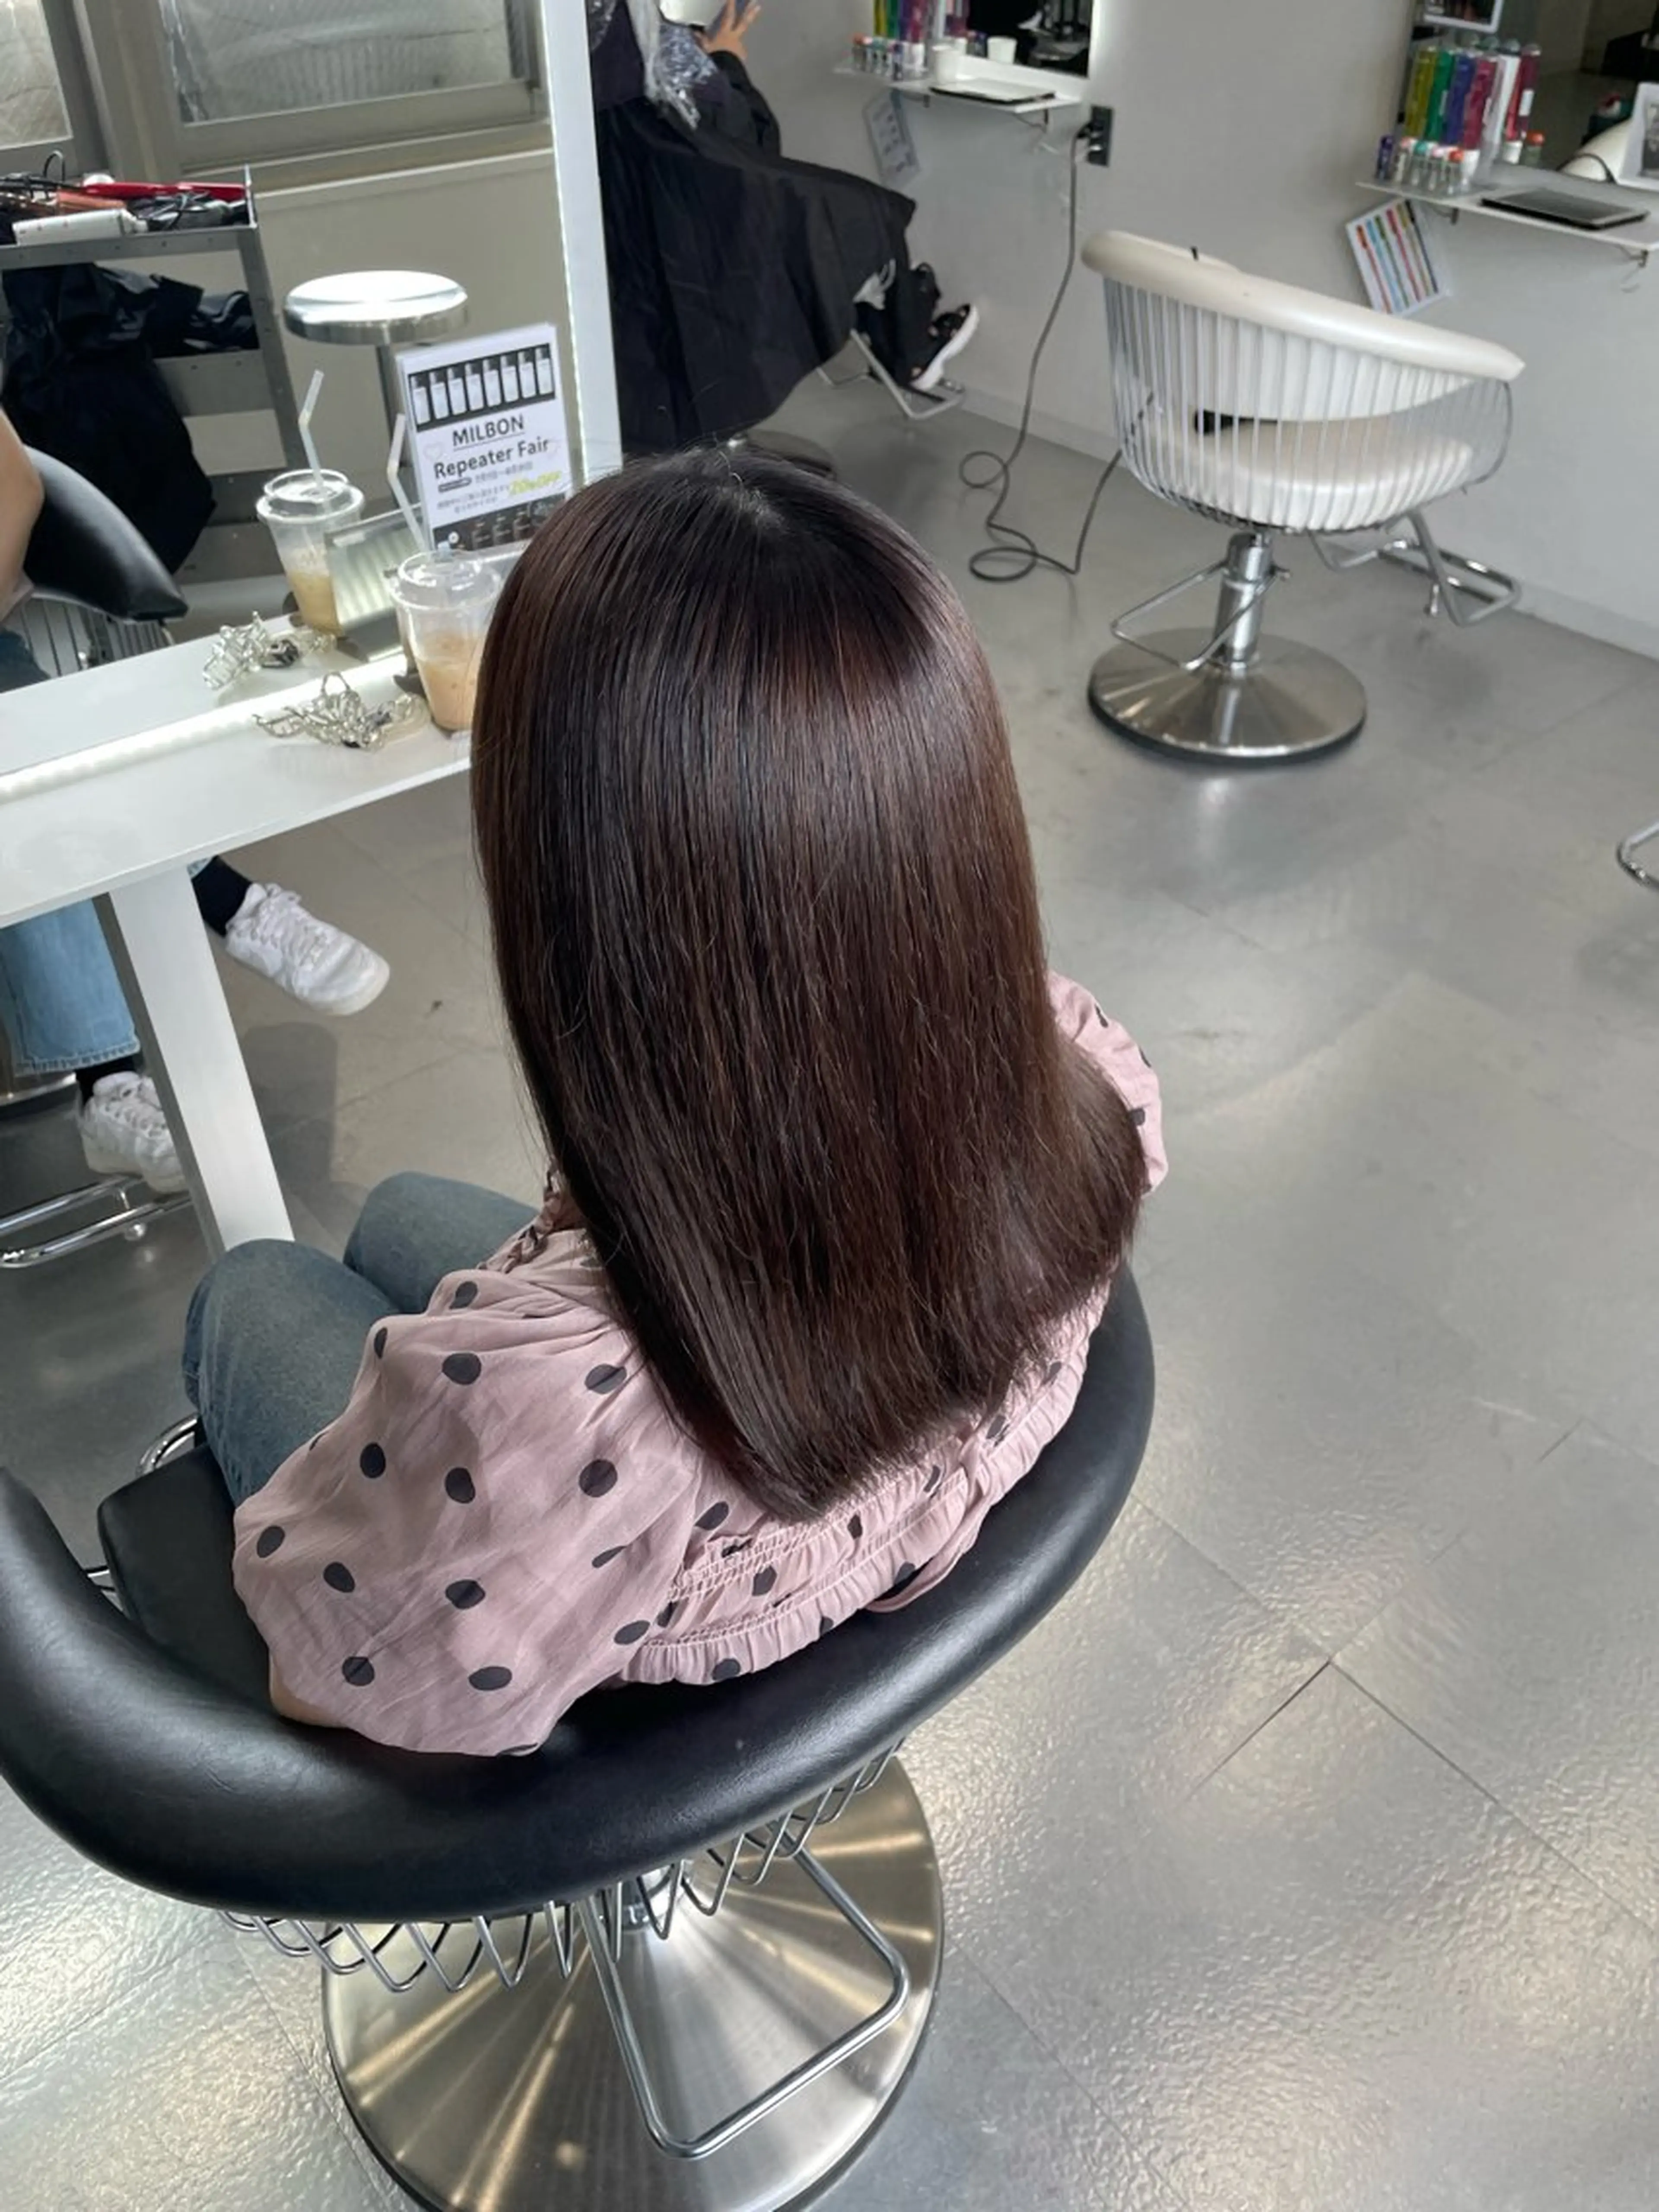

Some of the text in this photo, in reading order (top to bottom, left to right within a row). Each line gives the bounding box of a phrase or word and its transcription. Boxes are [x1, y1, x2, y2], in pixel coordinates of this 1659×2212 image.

[452, 413, 524, 446] MILBON
[434, 448, 513, 479] Repeater
[517, 436, 548, 457] Fair
